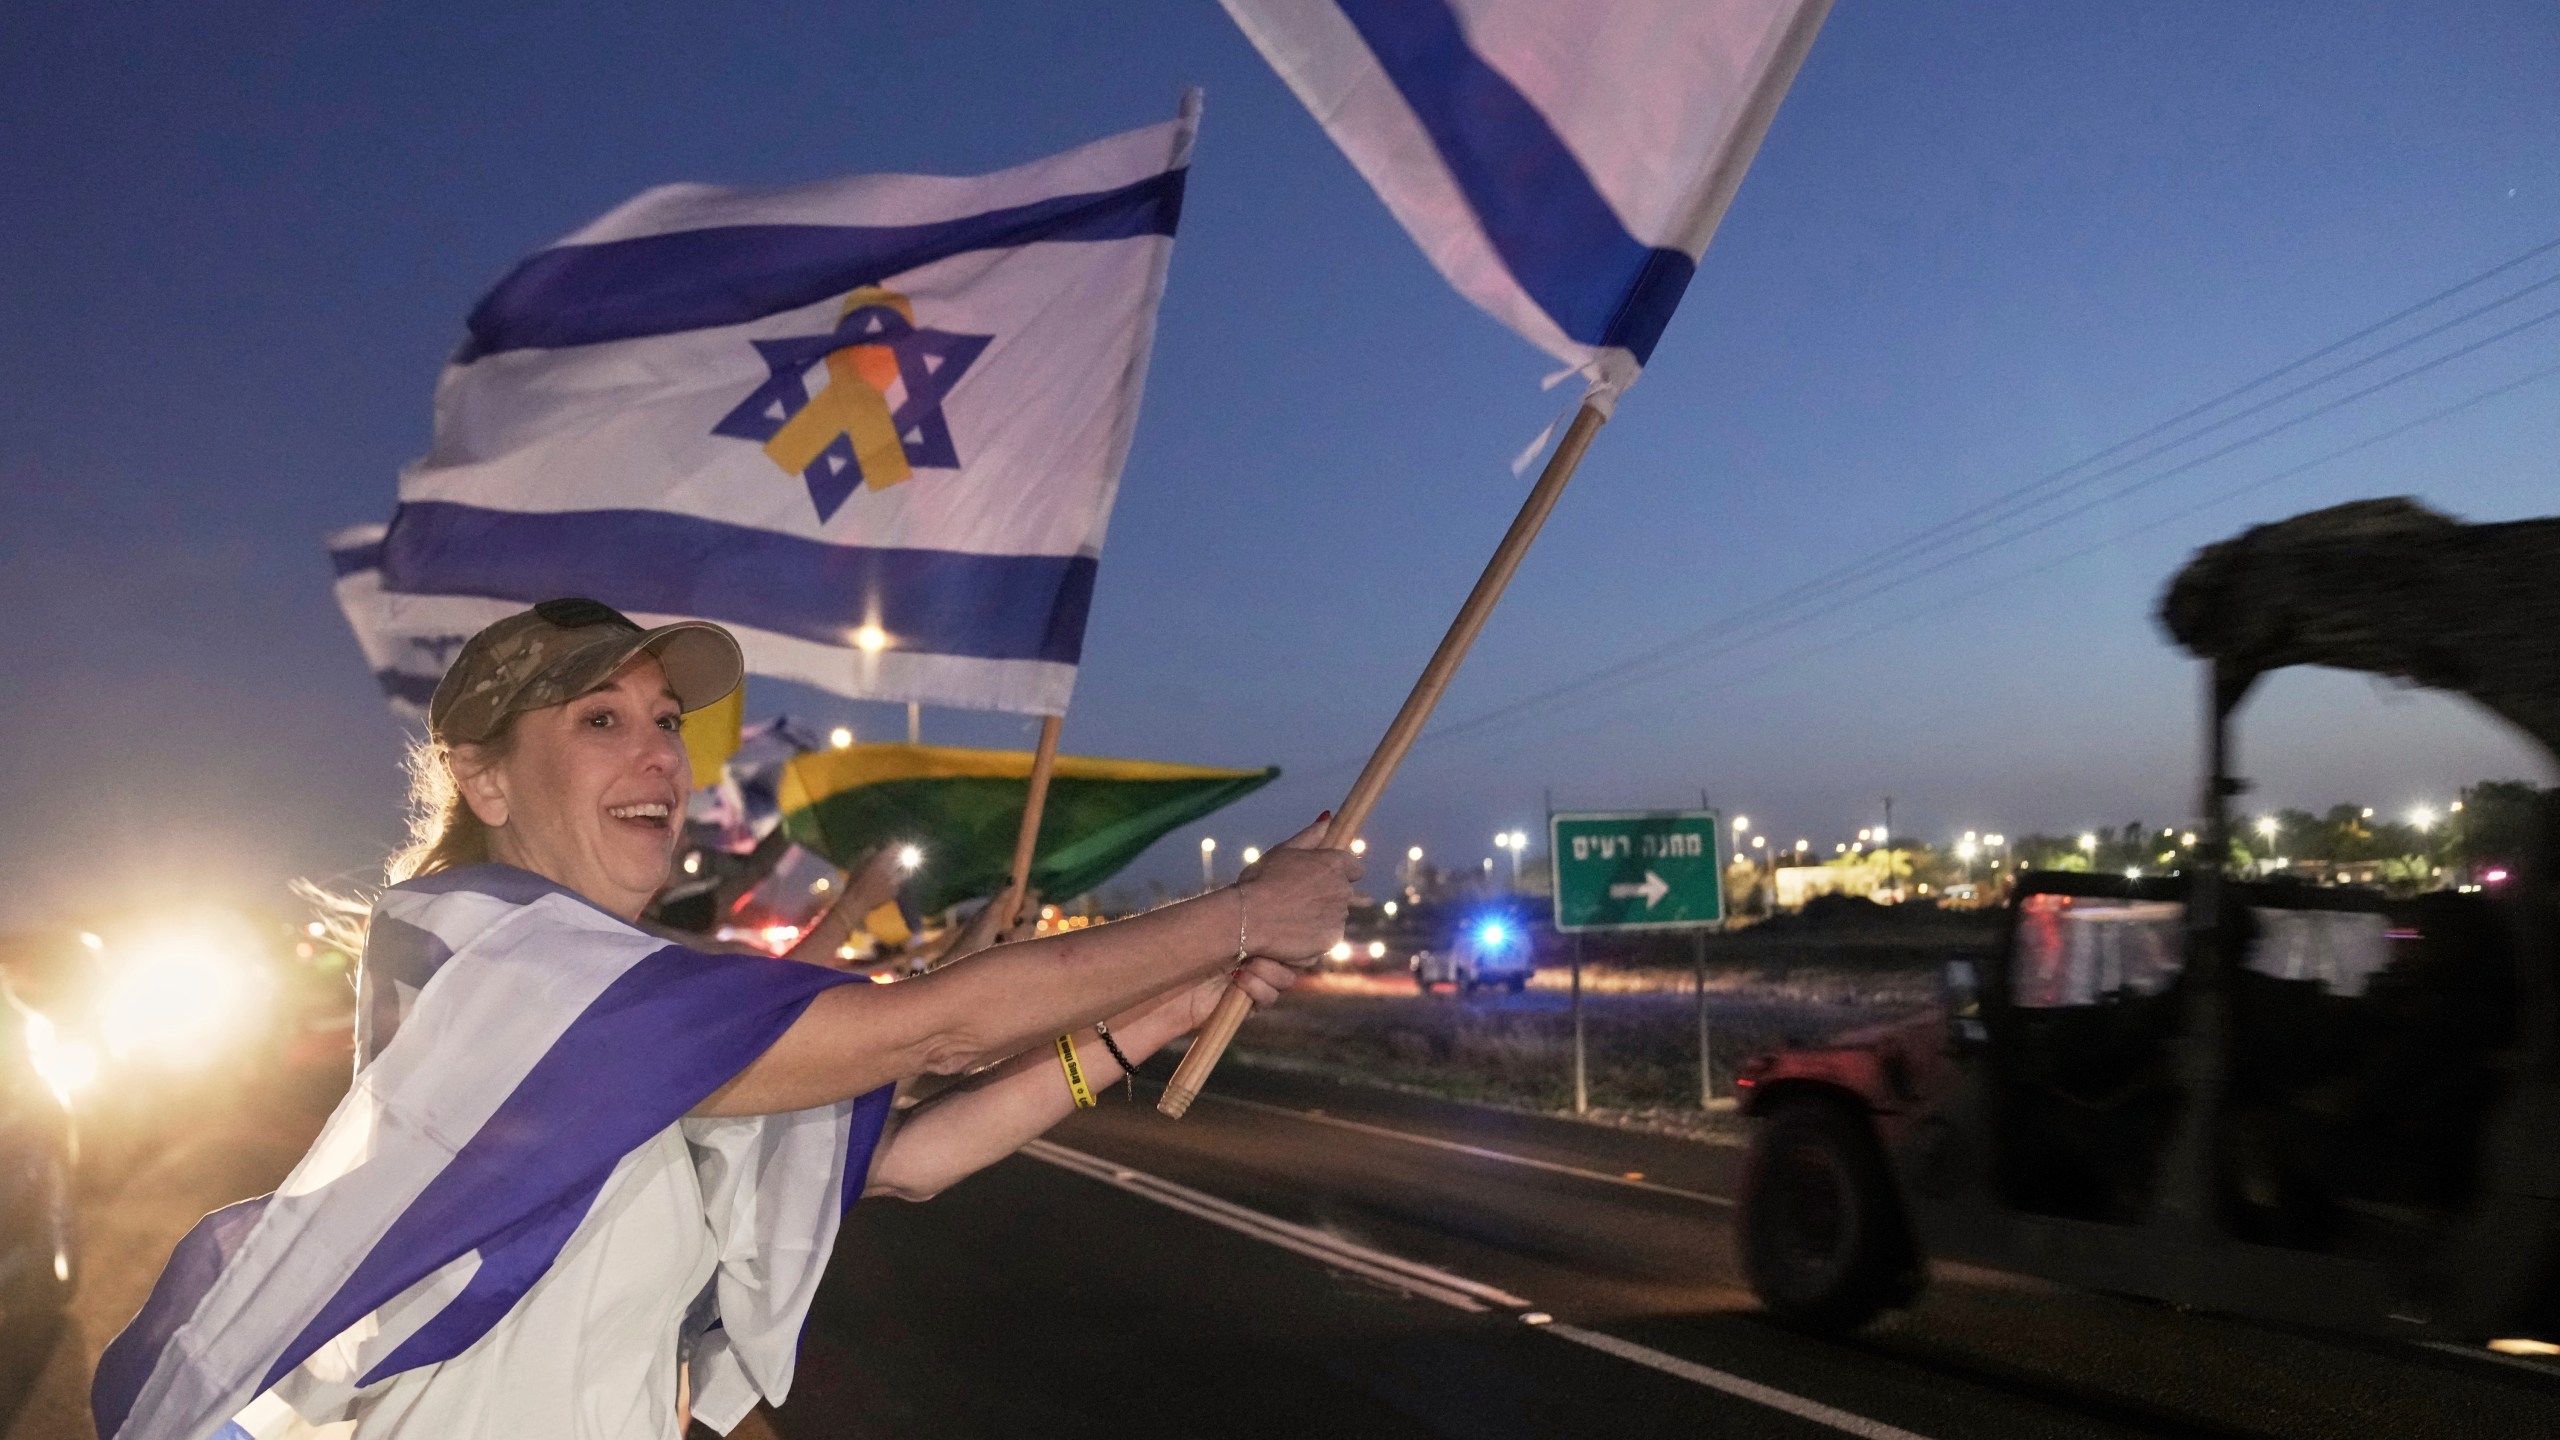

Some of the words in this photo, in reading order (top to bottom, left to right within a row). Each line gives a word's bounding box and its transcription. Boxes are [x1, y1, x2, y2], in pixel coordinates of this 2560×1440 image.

[1572, 834, 1631, 860] רעים
[1642, 833, 1702, 857] מחנה
[1061, 1041, 1073, 1062] them
[1068, 1062, 1081, 1084] Bring
